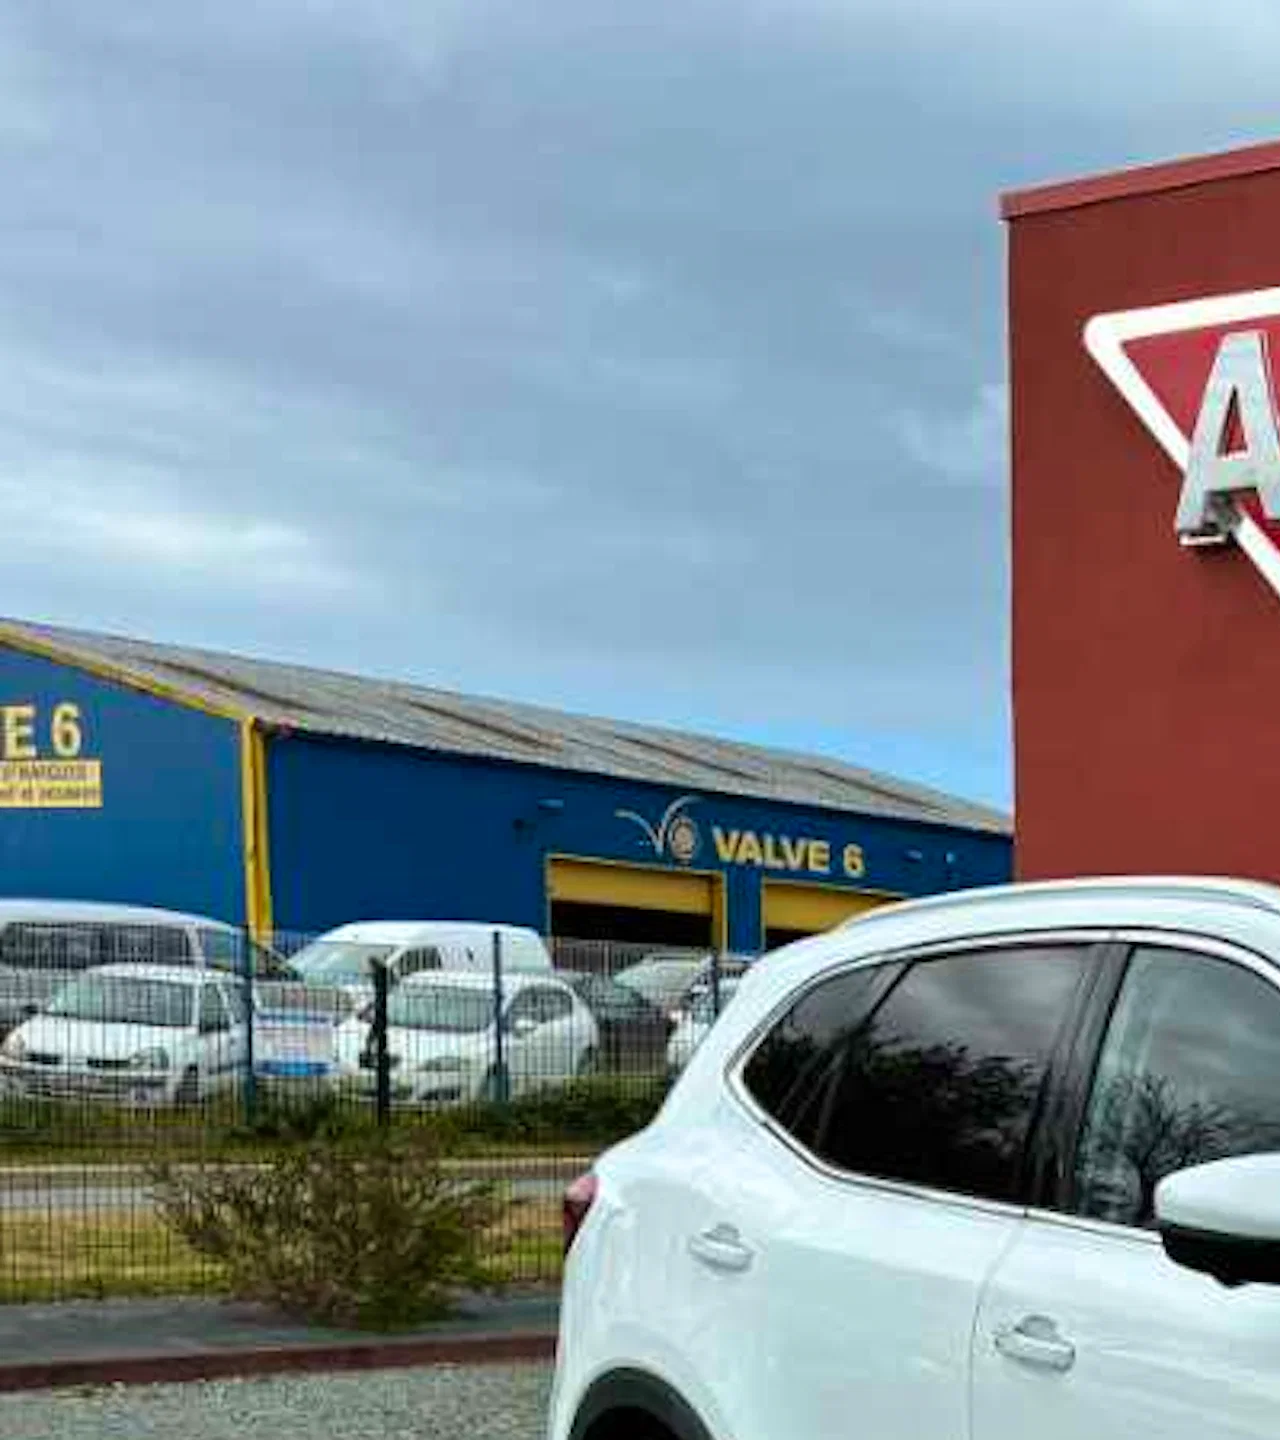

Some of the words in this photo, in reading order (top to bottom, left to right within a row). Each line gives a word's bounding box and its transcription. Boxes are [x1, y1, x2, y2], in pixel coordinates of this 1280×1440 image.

[51, 702, 82, 757] 6
[712, 825, 830, 874] VALVE
[842, 843, 865, 878] 6
